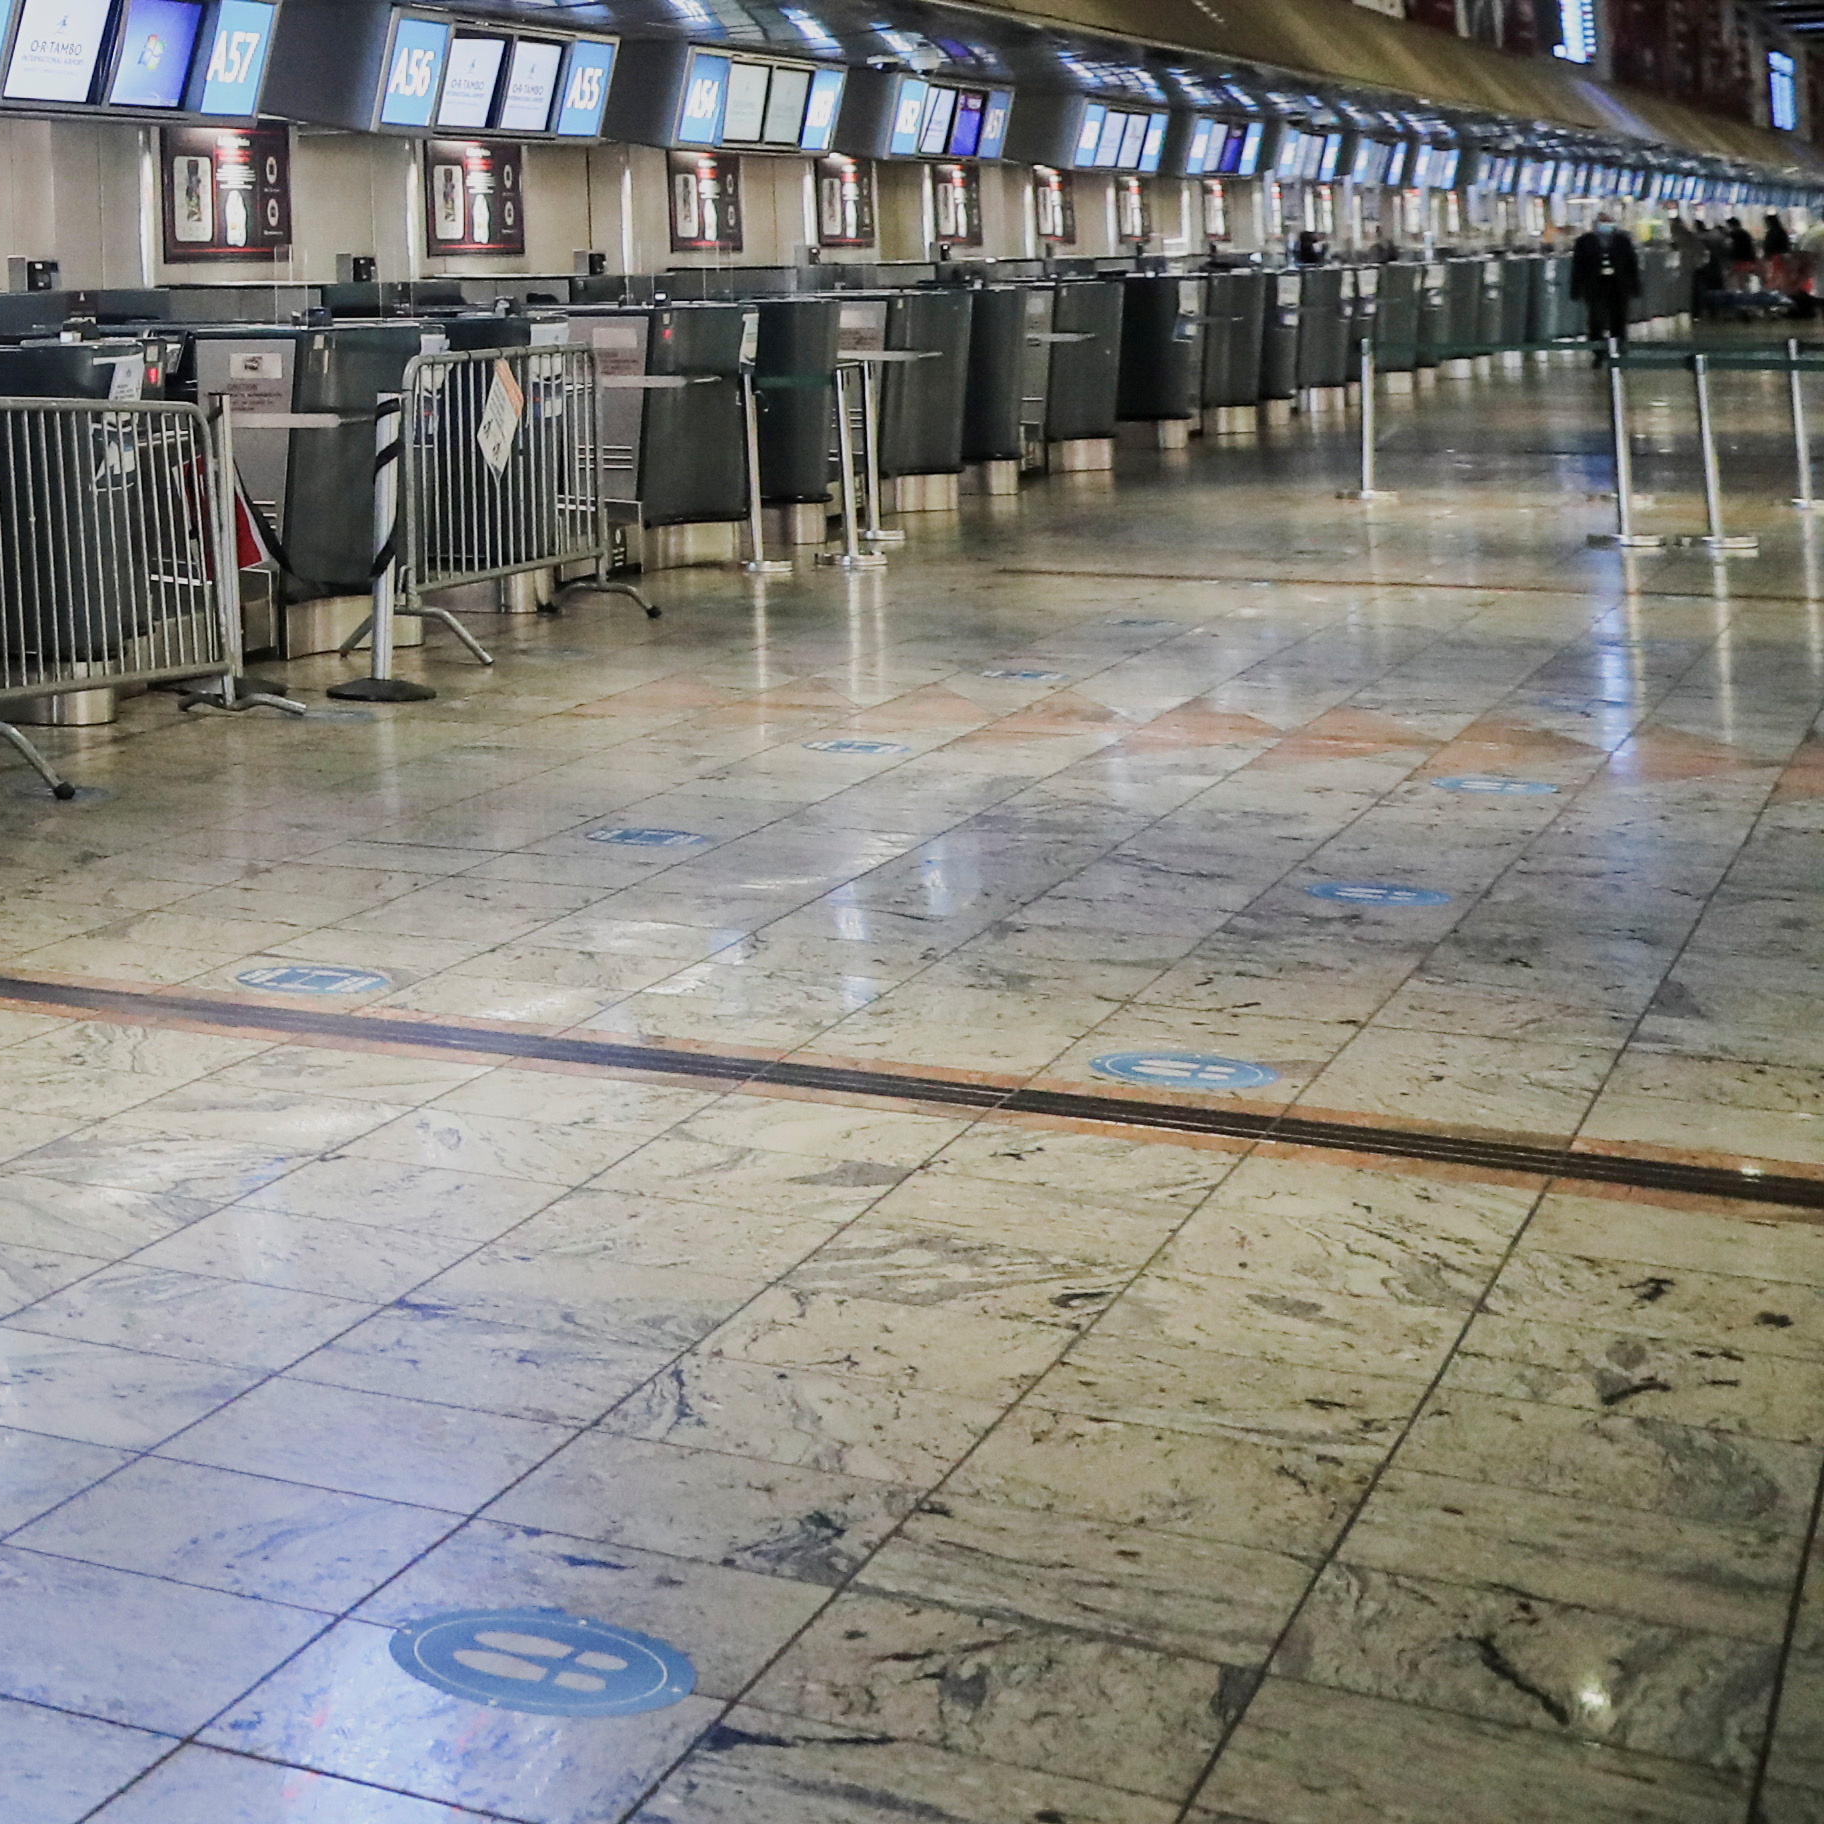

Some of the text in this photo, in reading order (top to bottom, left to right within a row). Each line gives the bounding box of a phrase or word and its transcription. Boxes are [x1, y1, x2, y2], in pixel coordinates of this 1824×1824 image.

[207, 30, 261, 83] A57
[390, 46, 433, 98] A56
[566, 66, 601, 110] A55
